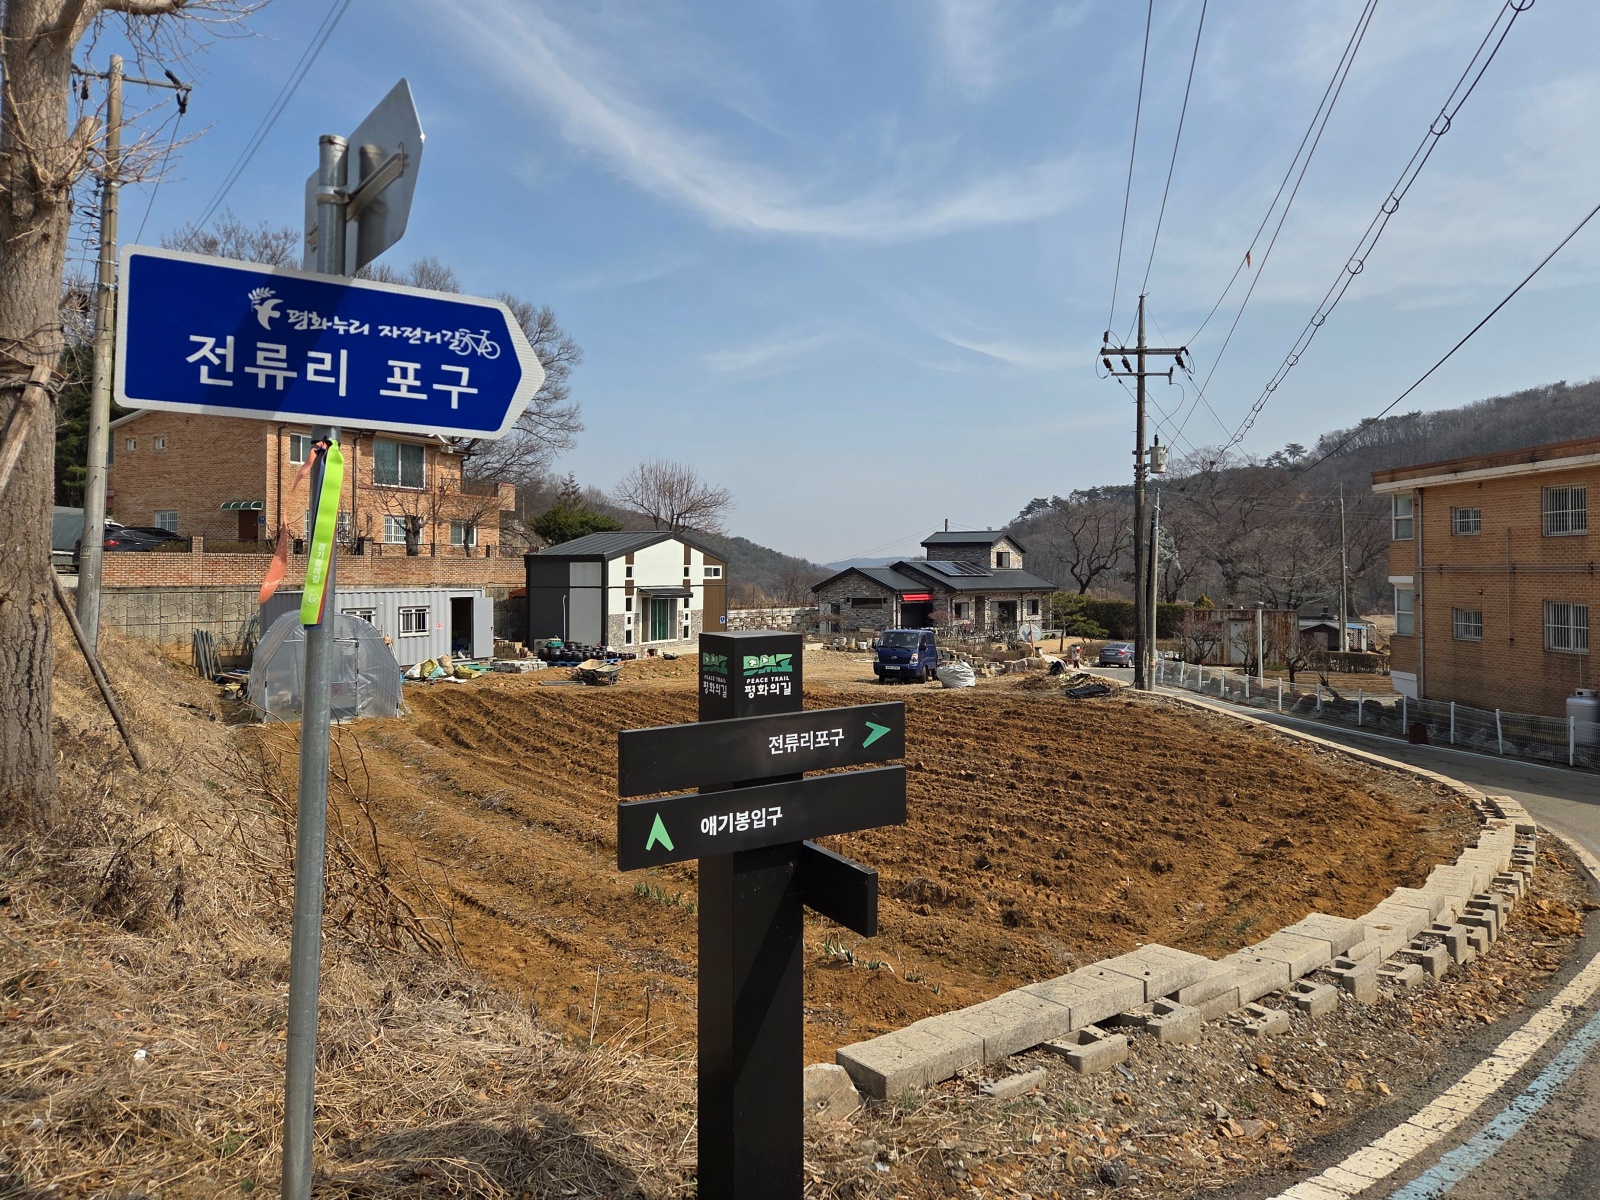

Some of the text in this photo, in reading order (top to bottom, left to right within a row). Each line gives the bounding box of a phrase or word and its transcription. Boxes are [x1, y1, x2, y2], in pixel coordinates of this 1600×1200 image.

[286, 309, 463, 351] 평화누리 자전거길
[185, 334, 479, 409] 전류리 포구
[703, 681, 728, 699] 평화의길
[744, 682, 792, 699] 평화의길
[768, 728, 845, 755] 전류리포구
[700, 806, 783, 836] 애기봉입구
